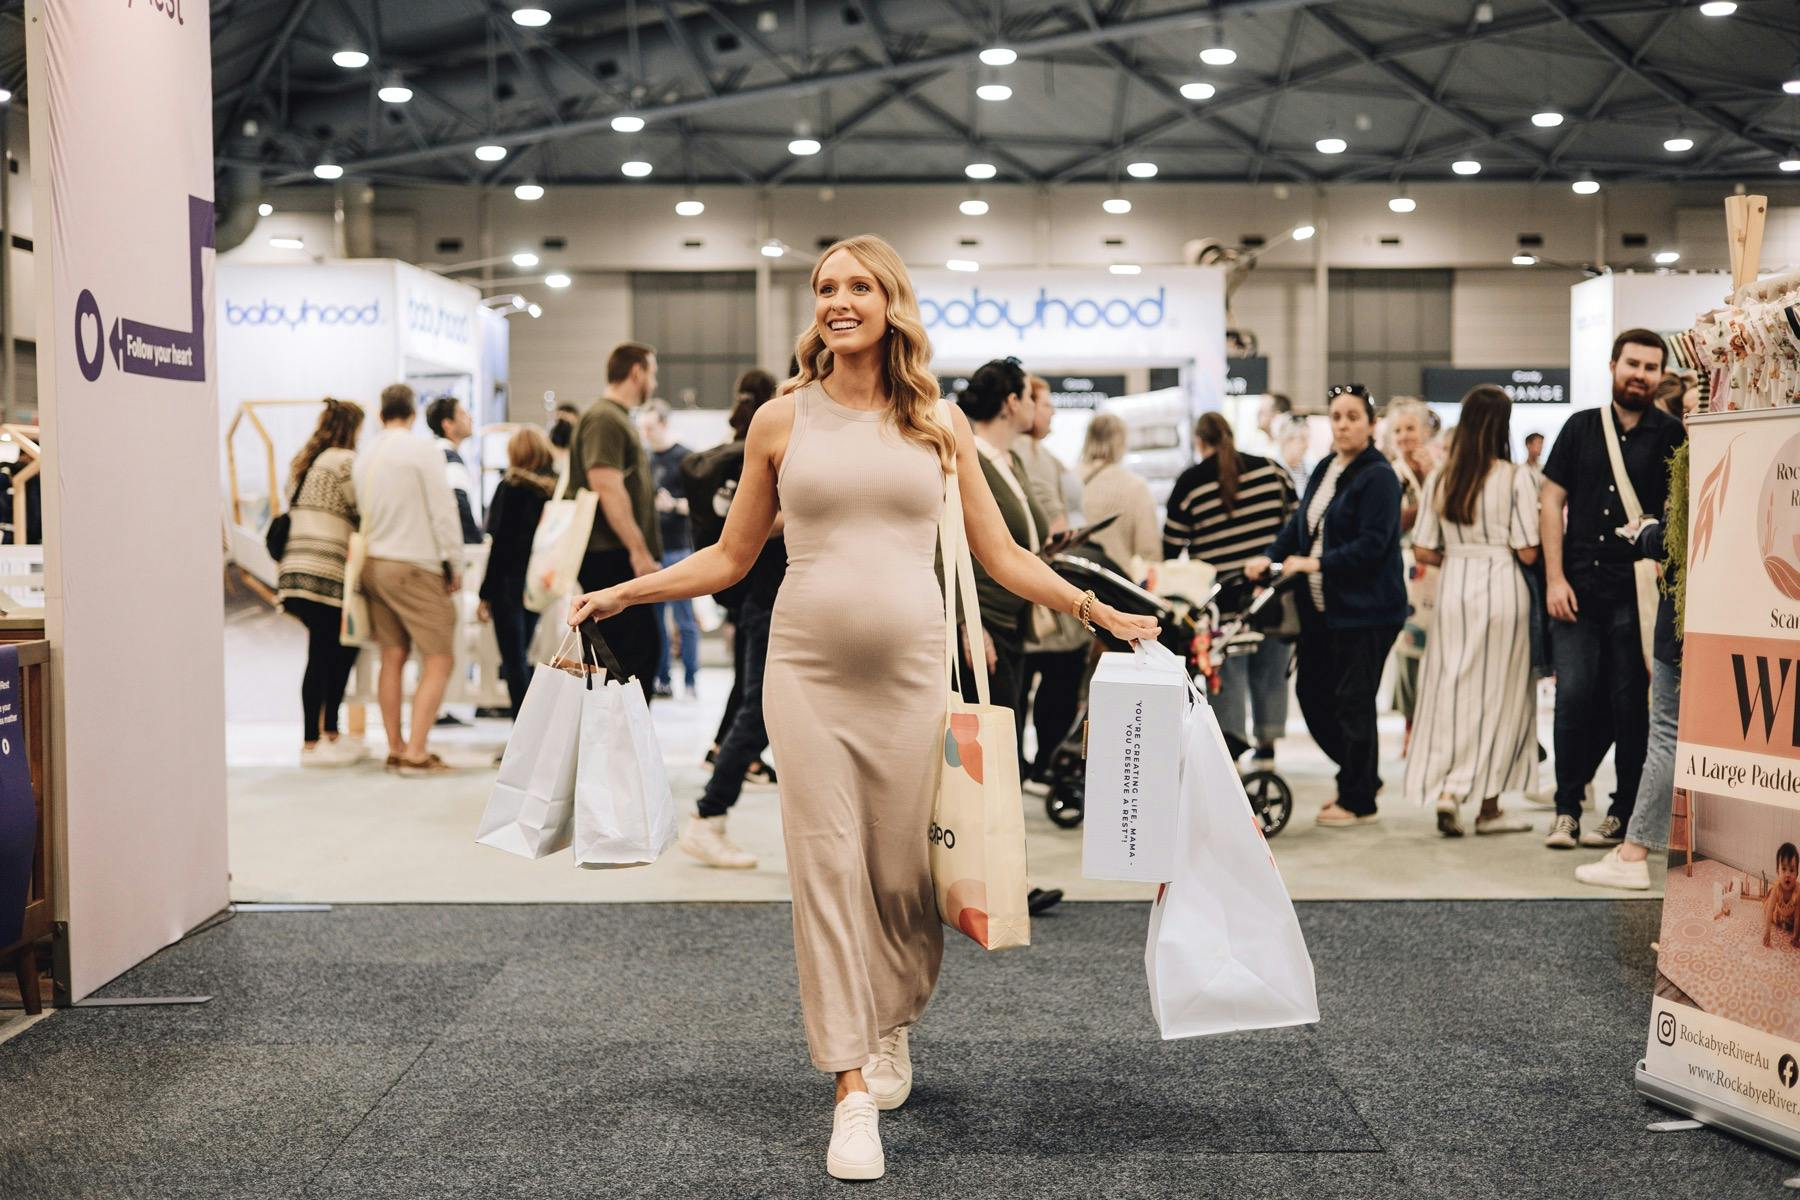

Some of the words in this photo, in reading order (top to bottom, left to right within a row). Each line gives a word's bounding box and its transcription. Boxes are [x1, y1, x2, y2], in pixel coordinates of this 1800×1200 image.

[226, 299, 379, 331] babyhood
[126, 334, 154, 360] Follow
[154, 345, 172, 367] your
[171, 343, 193, 367] heart
[1496, 384, 1564, 401] RANGE
[1125, 723, 1133, 744] YOU
[1123, 748, 1132, 794] DESERVE
[1131, 743, 1140, 794] CREATING
[1686, 754, 1696, 776] A
[1701, 756, 1746, 789] Large
[1130, 798, 1138, 824] LIFE,
[1129, 828, 1137, 858] MAMA
[1680, 1023, 1770, 1070] RockabyeRiverAu
